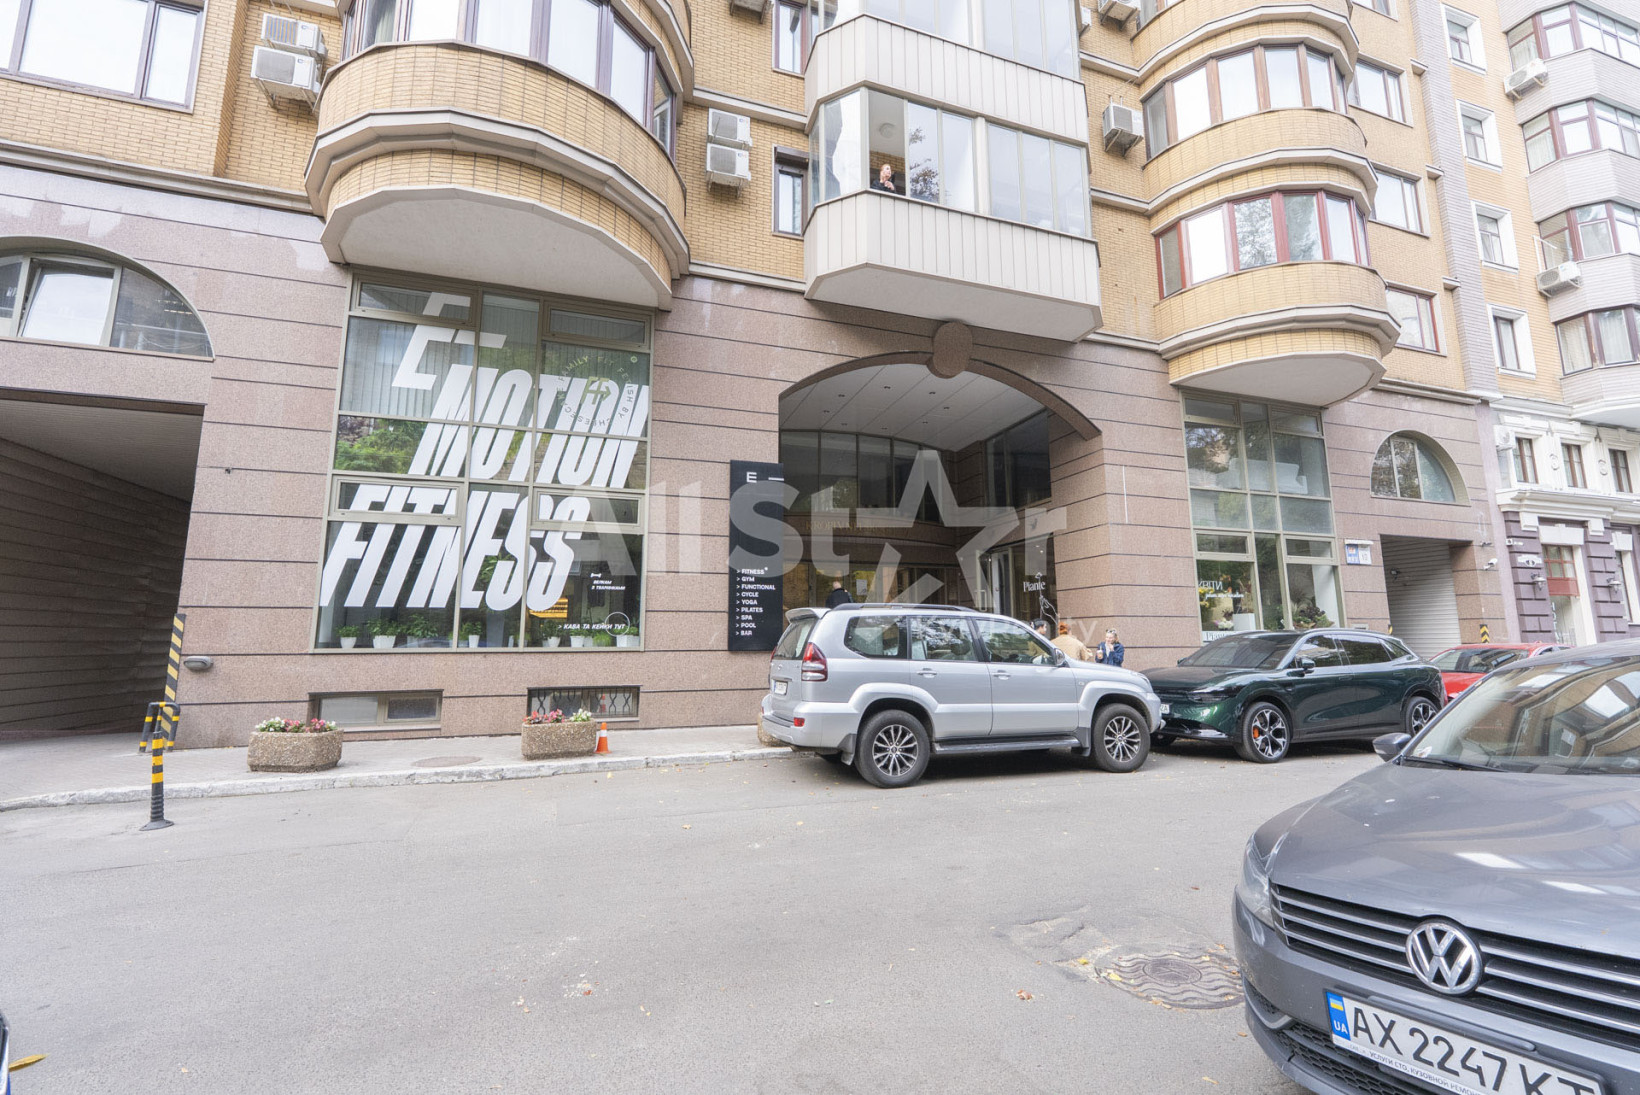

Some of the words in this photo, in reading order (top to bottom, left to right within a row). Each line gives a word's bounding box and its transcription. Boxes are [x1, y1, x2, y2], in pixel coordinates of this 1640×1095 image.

[617, 406, 630, 419] BY
[319, 483, 591, 612] FITNESS
[1333, 1019, 1348, 1035] UA
[1353, 1007, 1403, 1056] AX
[1409, 1027, 1508, 1092] 2247
